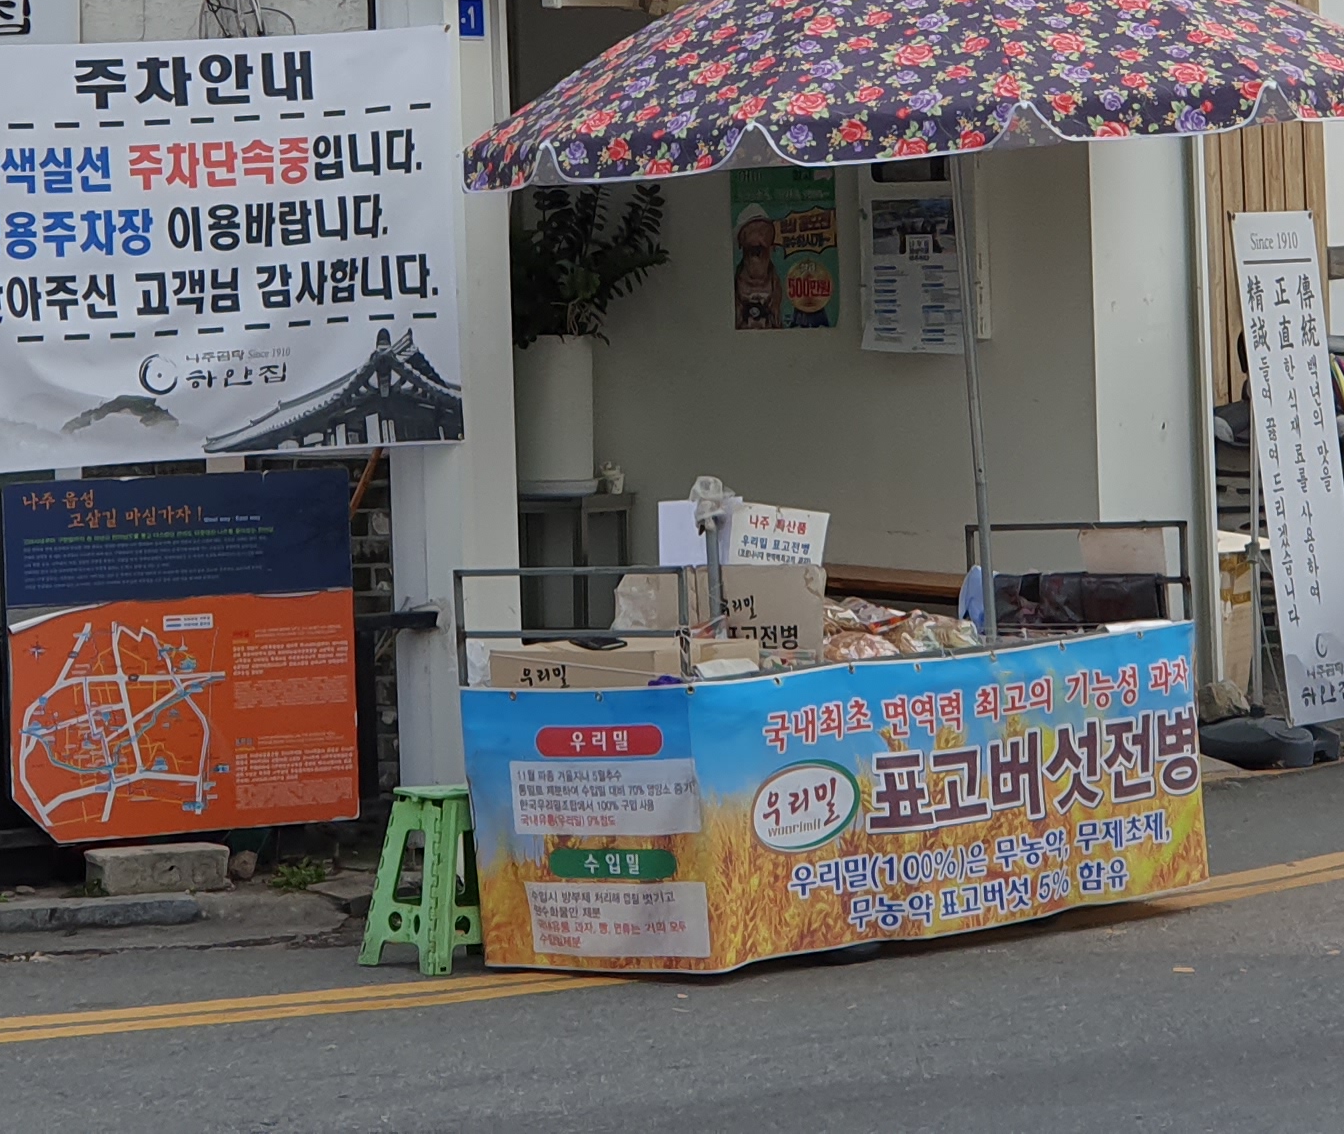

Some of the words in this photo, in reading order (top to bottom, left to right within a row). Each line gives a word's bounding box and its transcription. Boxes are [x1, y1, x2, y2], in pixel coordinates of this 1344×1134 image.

[74, 51, 314, 110] 주차안내
[128, 128, 422, 191] 주차단속중입니다.
[167, 194, 388, 253] 이용바랍니다.
[1250, 232, 1274, 250] Since
[1276, 231, 1299, 250] 1910
[135, 265, 240, 319] 고객님
[257, 253, 439, 312] 감사합니다.
[788, 277, 831, 299] 500만원
[1296, 273, 1320, 347] 傳統
[186, 362, 287, 389] 하얀집
[271, 346, 291, 358] 1910
[1306, 354, 1325, 431] 백년의
[1317, 440, 1332, 493] 맛을
[23, 492, 56, 511] 나주
[62, 490, 95, 509] 읍성
[749, 514, 770, 530] 나주
[741, 534, 768, 550] 우리밀
[520, 664, 570, 689] 우리밀
[764, 698, 872, 752] 국내최초
[882, 691, 963, 737] 면역력
[975, 678, 1053, 721] 최고의
[1065, 663, 1139, 709] 기능성
[1150, 657, 1190, 695] 과자
[570, 729, 629, 752] 우리밀
[868, 704, 1200, 830] 표고버섯전병
[597, 799, 619, 811] 100%
[762, 776, 841, 827] 우리밀
[584, 853, 640, 875] 수입밀
[789, 845, 987, 898] 우리밀(100%)은
[995, 829, 1070, 871] 무농약,
[1076, 810, 1173, 853] 무제초제,
[849, 890, 933, 931] 무농약
[940, 878, 1031, 919] 표고버섯
[1038, 870, 1070, 902] 5%
[1079, 860, 1129, 893] 함유
